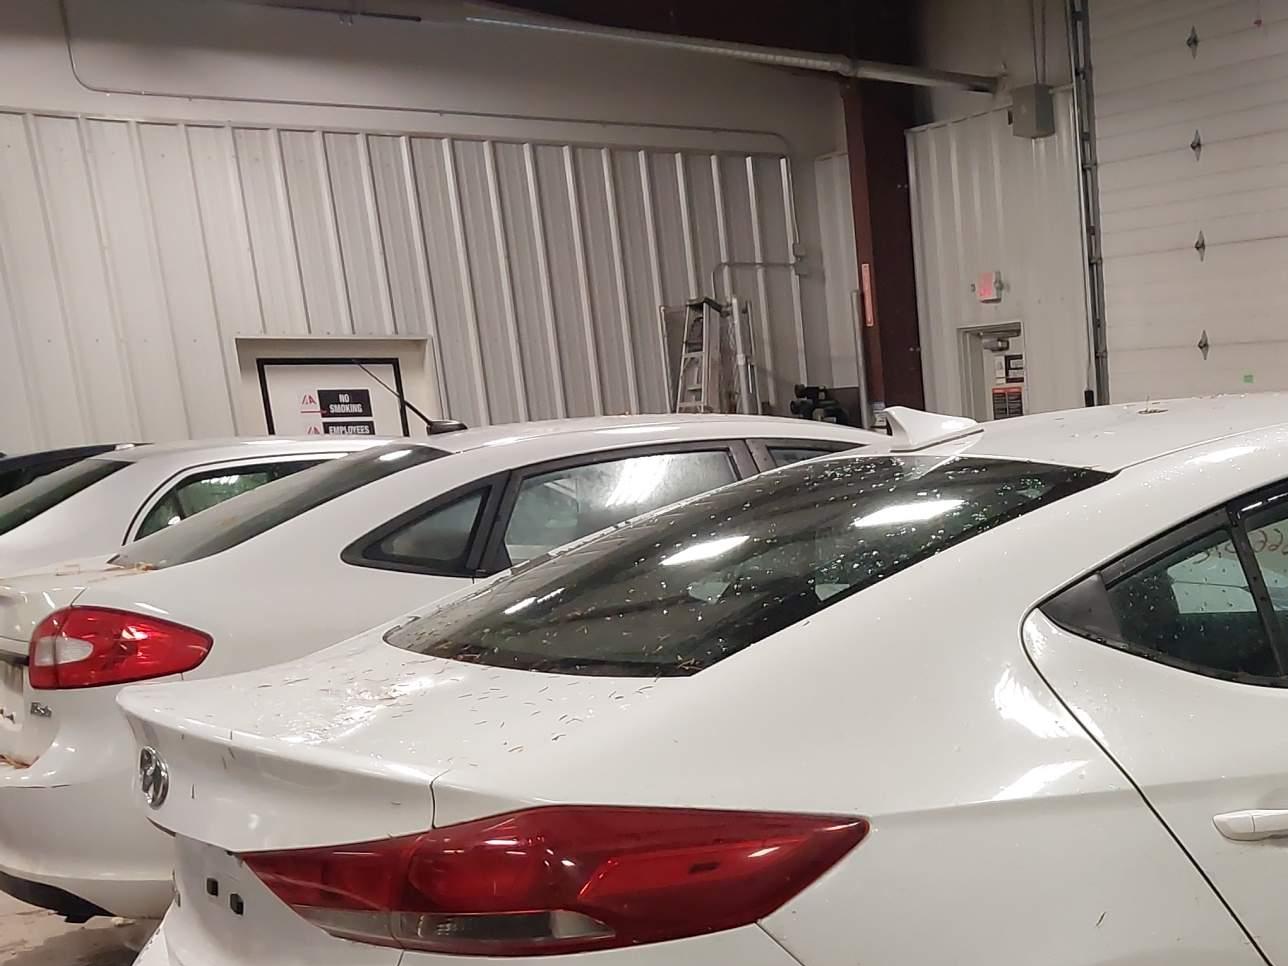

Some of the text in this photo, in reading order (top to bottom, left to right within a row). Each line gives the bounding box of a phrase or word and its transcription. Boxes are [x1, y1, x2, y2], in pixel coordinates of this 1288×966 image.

[339, 394, 350, 403] NO
[329, 404, 363, 413] SMOKING
[328, 426, 370, 434] EMPLOYEES
